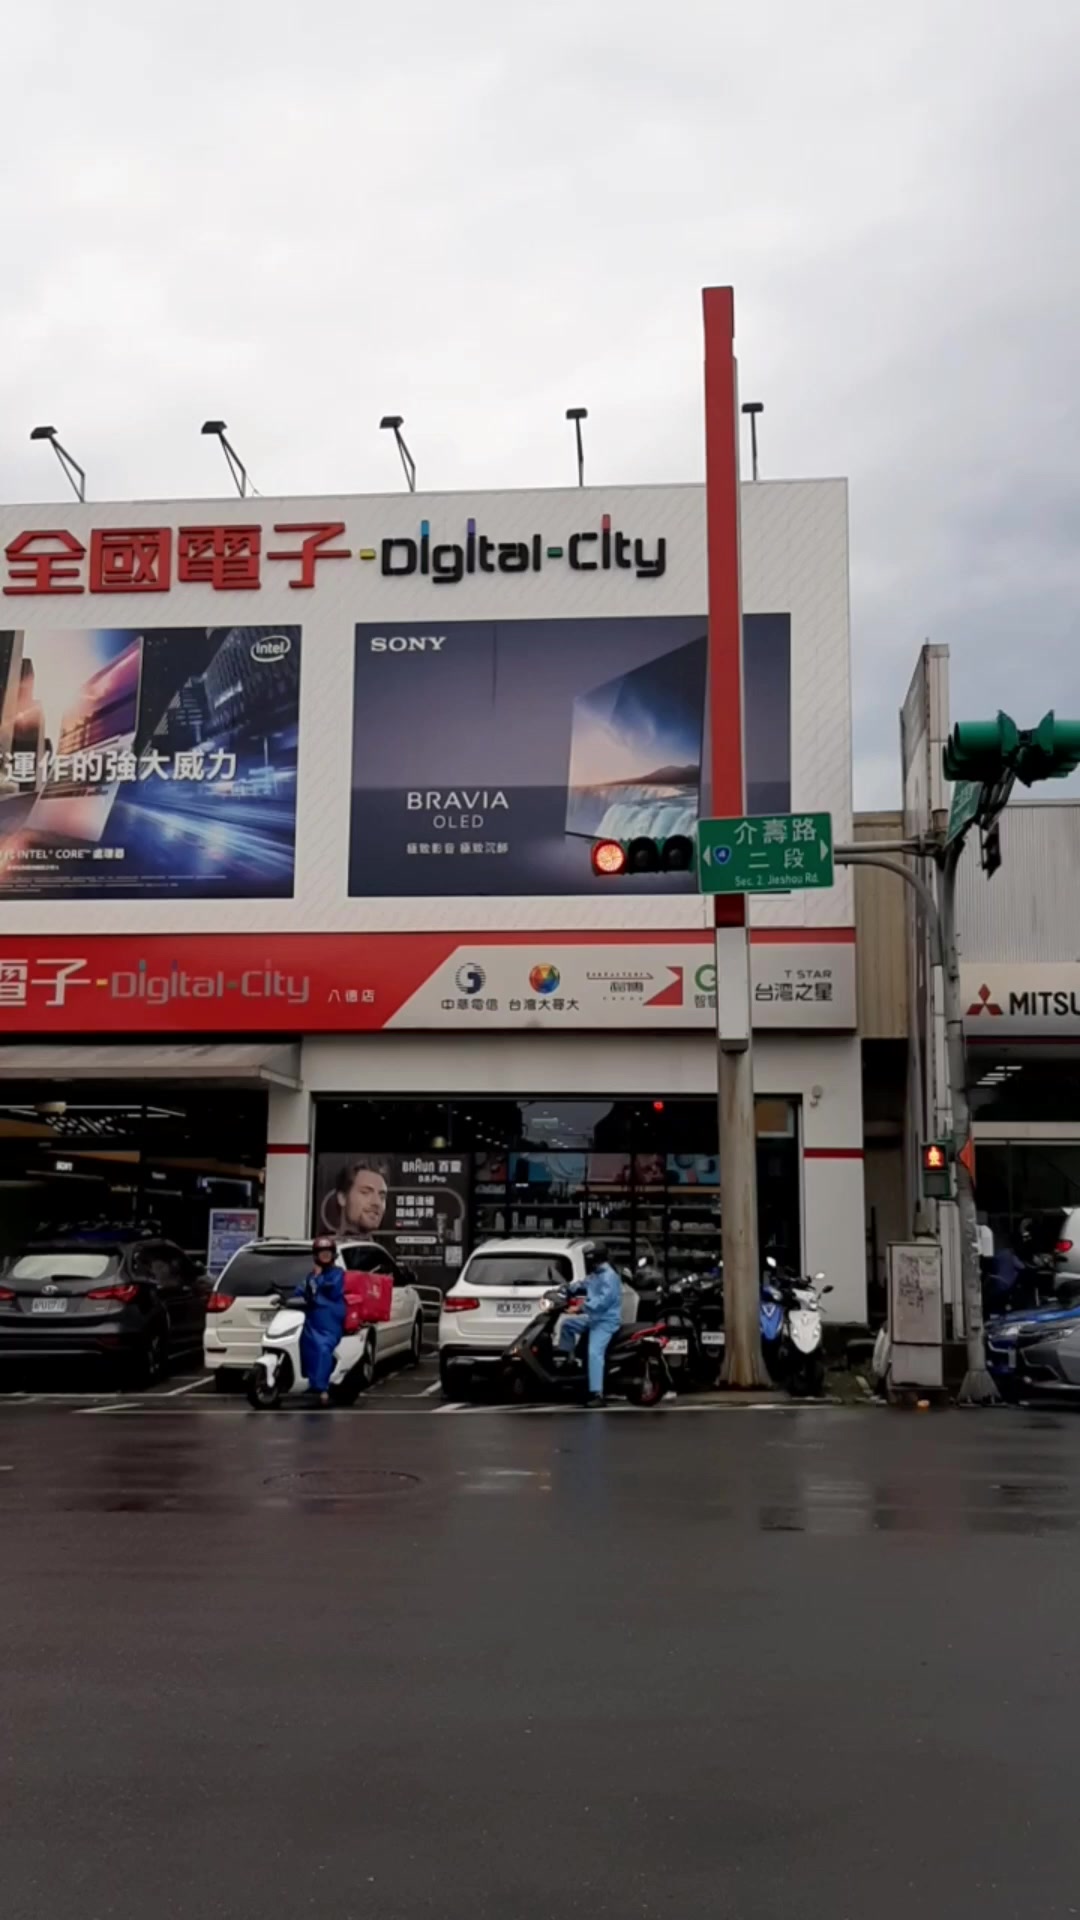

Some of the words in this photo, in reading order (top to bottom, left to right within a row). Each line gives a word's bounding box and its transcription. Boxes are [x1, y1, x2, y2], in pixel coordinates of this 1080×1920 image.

[2, 523, 352, 595] 全國電子
[370, 636, 446, 652] SONY
[0, 748, 237, 782] 運作的強大威力
[406, 791, 509, 810] BRAVIA
[433, 814, 484, 829] OLED
[734, 818, 817, 845] 介壽路
[748, 848, 805, 869] 二段
[784, 970, 791, 979] T
[796, 969, 832, 979] STAR
[440, 998, 499, 1011] 中華電信
[508, 998, 580, 1011] 台灣大哥大
